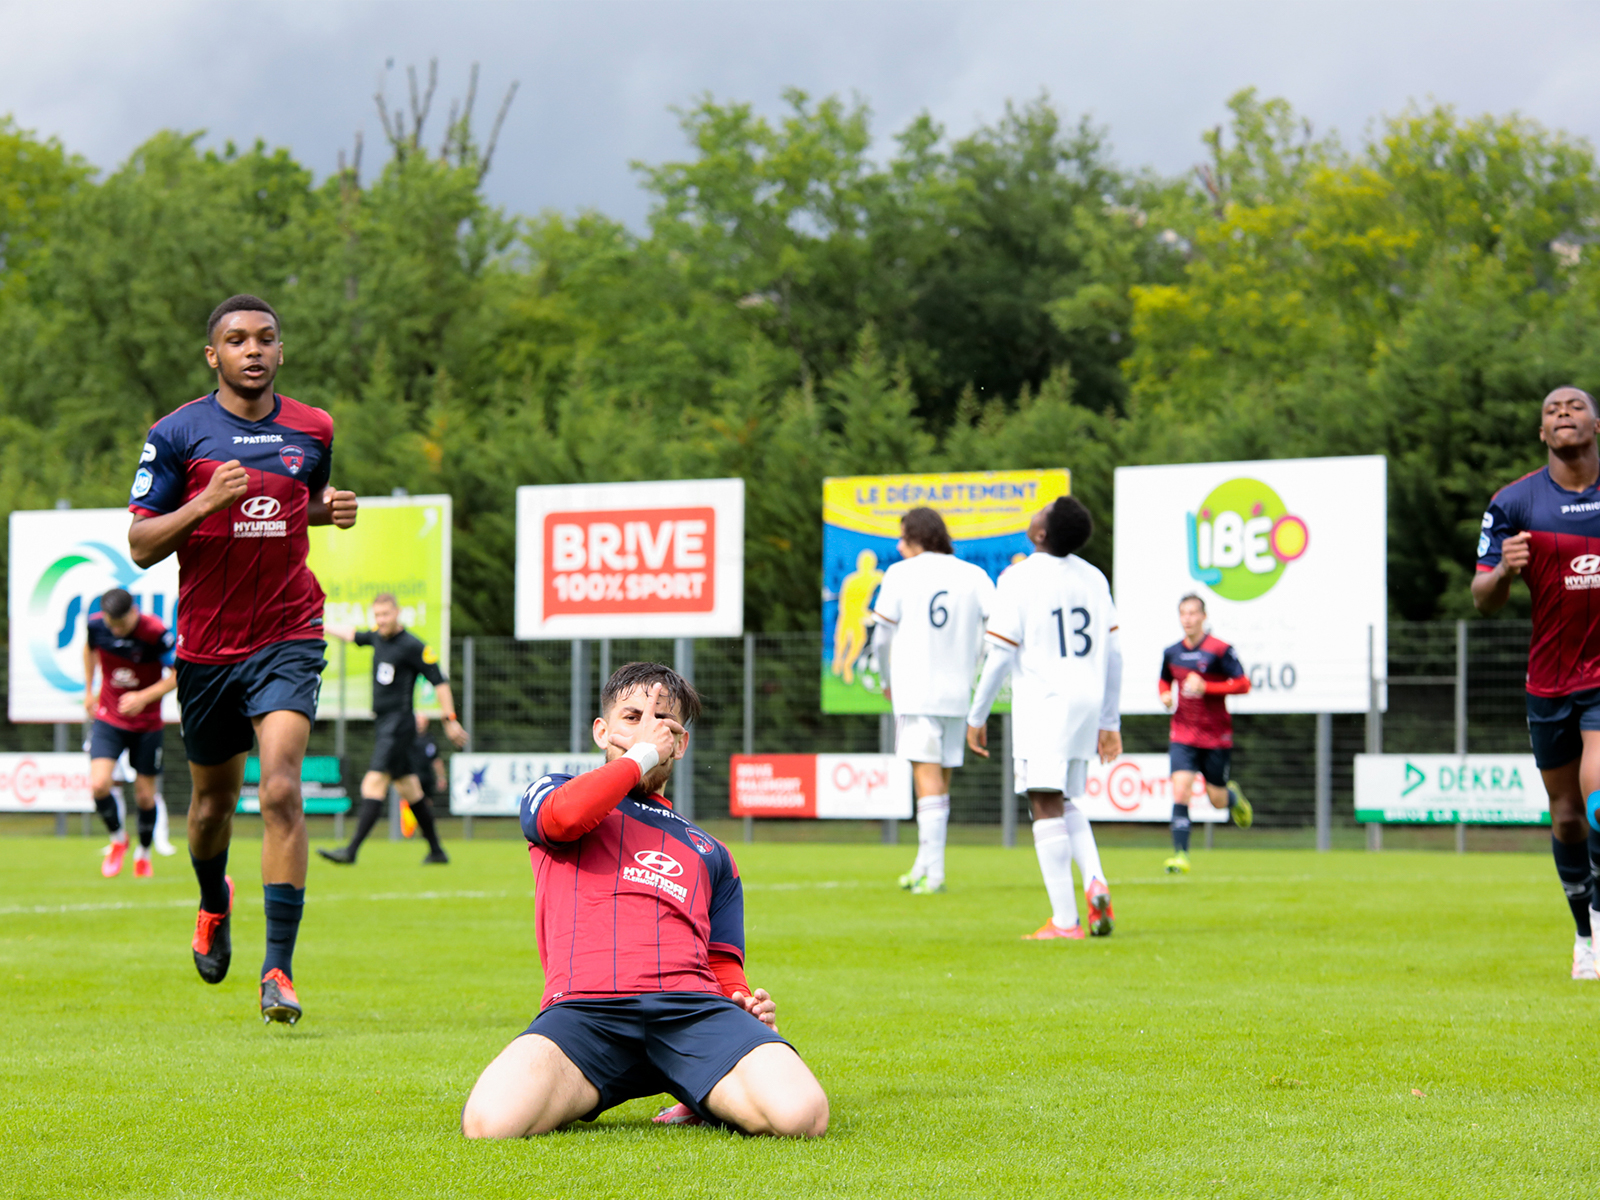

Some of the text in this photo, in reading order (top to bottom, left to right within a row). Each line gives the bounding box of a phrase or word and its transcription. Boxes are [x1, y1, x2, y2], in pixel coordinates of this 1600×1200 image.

[243, 434, 284, 444] PATRICK
[857, 487, 879, 504] LE
[233, 520, 287, 532] HYUNDAI
[552, 571, 707, 602] 100% SPORT
[929, 590, 949, 628] 6
[1051, 607, 1093, 658] 13
[1439, 765, 1525, 791] DEKRA
[623, 866, 688, 898] HYUNDAI
